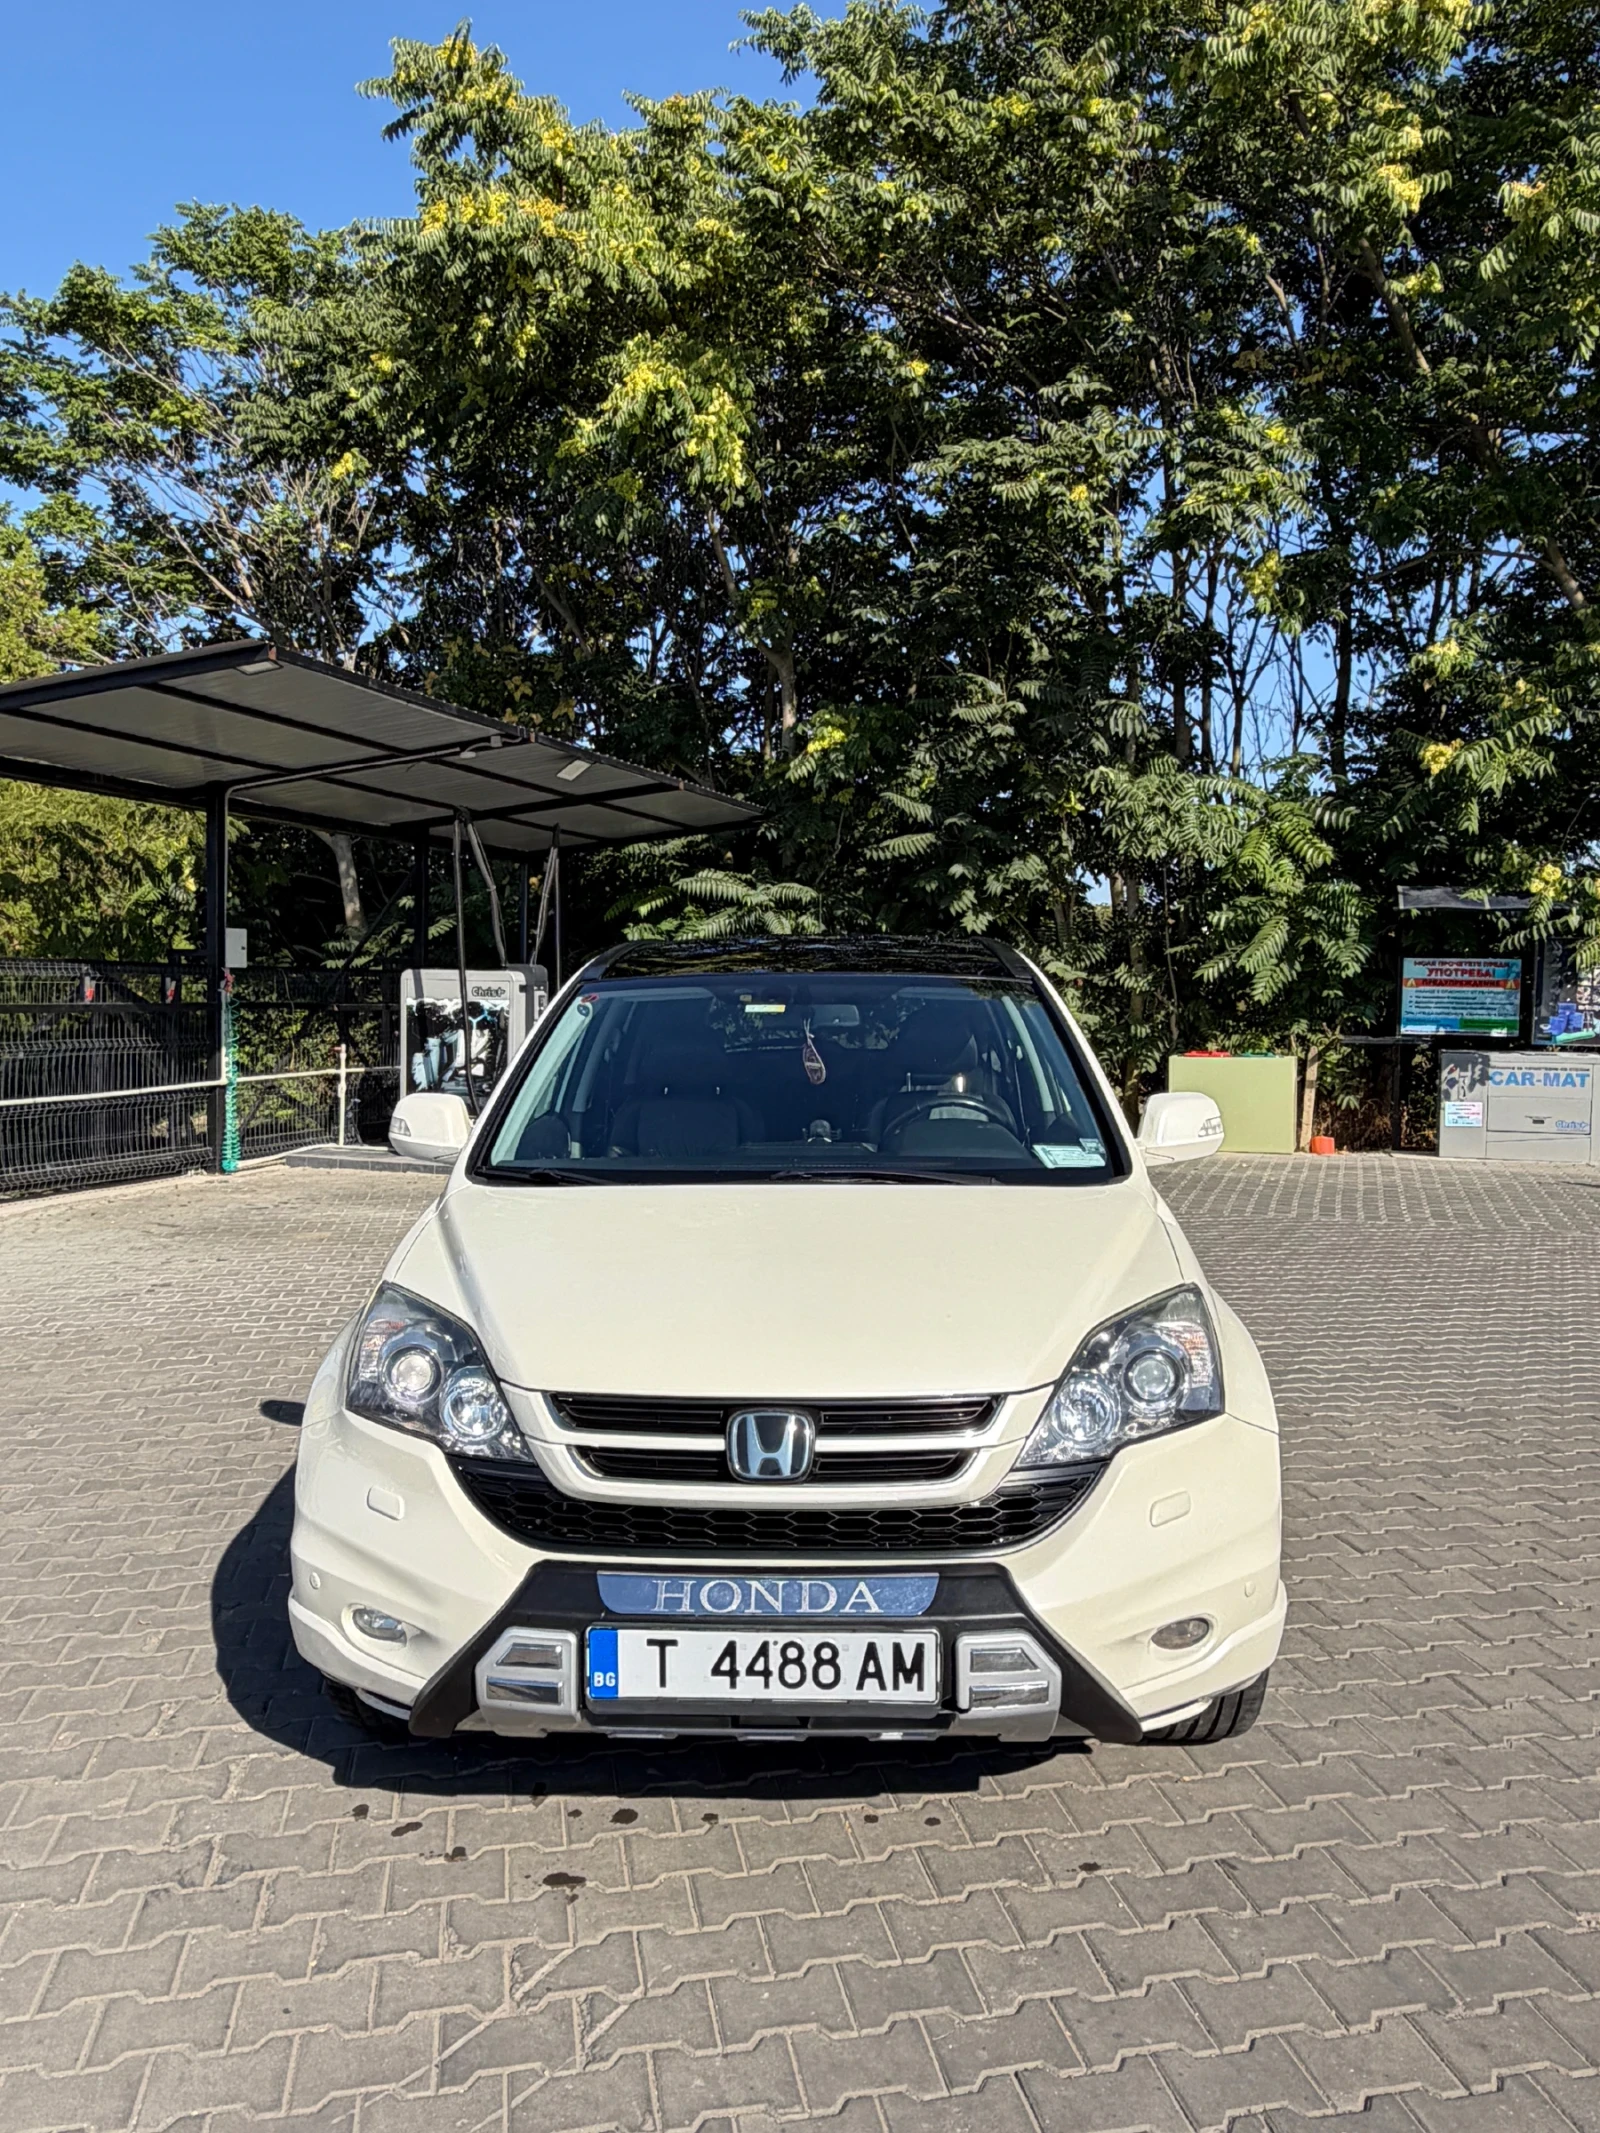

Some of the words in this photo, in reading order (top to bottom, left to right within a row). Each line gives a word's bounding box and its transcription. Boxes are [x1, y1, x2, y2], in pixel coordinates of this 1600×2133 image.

[1426, 967, 1496, 978] УПОТРЕБА!
[471, 986, 505, 997] Christ
[1490, 1071, 1590, 1088] CAR-MAT
[651, 1579, 884, 1613] HONDA
[646, 1638, 679, 1688] T
[710, 1640, 841, 1690] 4488
[856, 1641, 925, 1692] AM
[593, 1671, 616, 1687] BG
